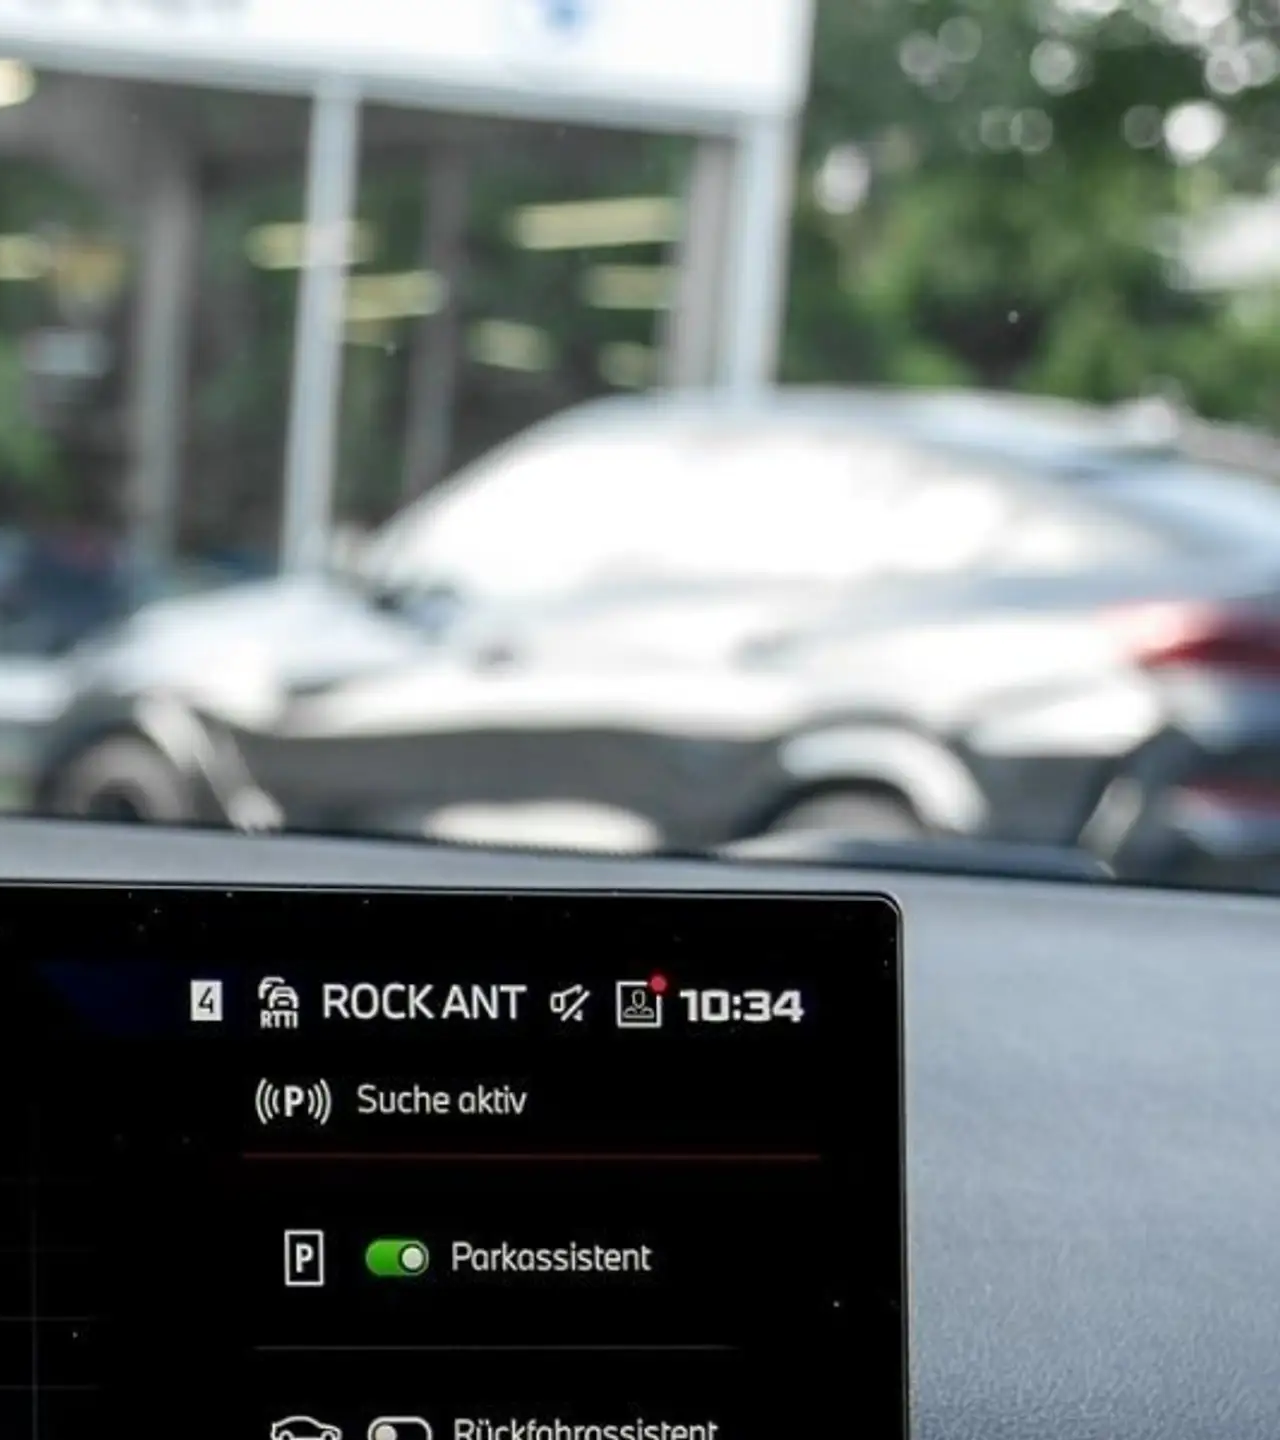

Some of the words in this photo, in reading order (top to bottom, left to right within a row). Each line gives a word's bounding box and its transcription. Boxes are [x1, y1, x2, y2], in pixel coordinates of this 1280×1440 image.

[197, 985, 216, 1016] 4
[260, 1009, 299, 1029] RTTI
[323, 982, 435, 1020] ROCK
[441, 984, 528, 1020] ANT
[679, 989, 805, 1024] 10:34
[284, 1085, 304, 1117] P
[357, 1084, 450, 1114] Suche
[458, 1084, 527, 1114] aktiv
[295, 1243, 314, 1273] P
[452, 1241, 652, 1271] Parkassistent
